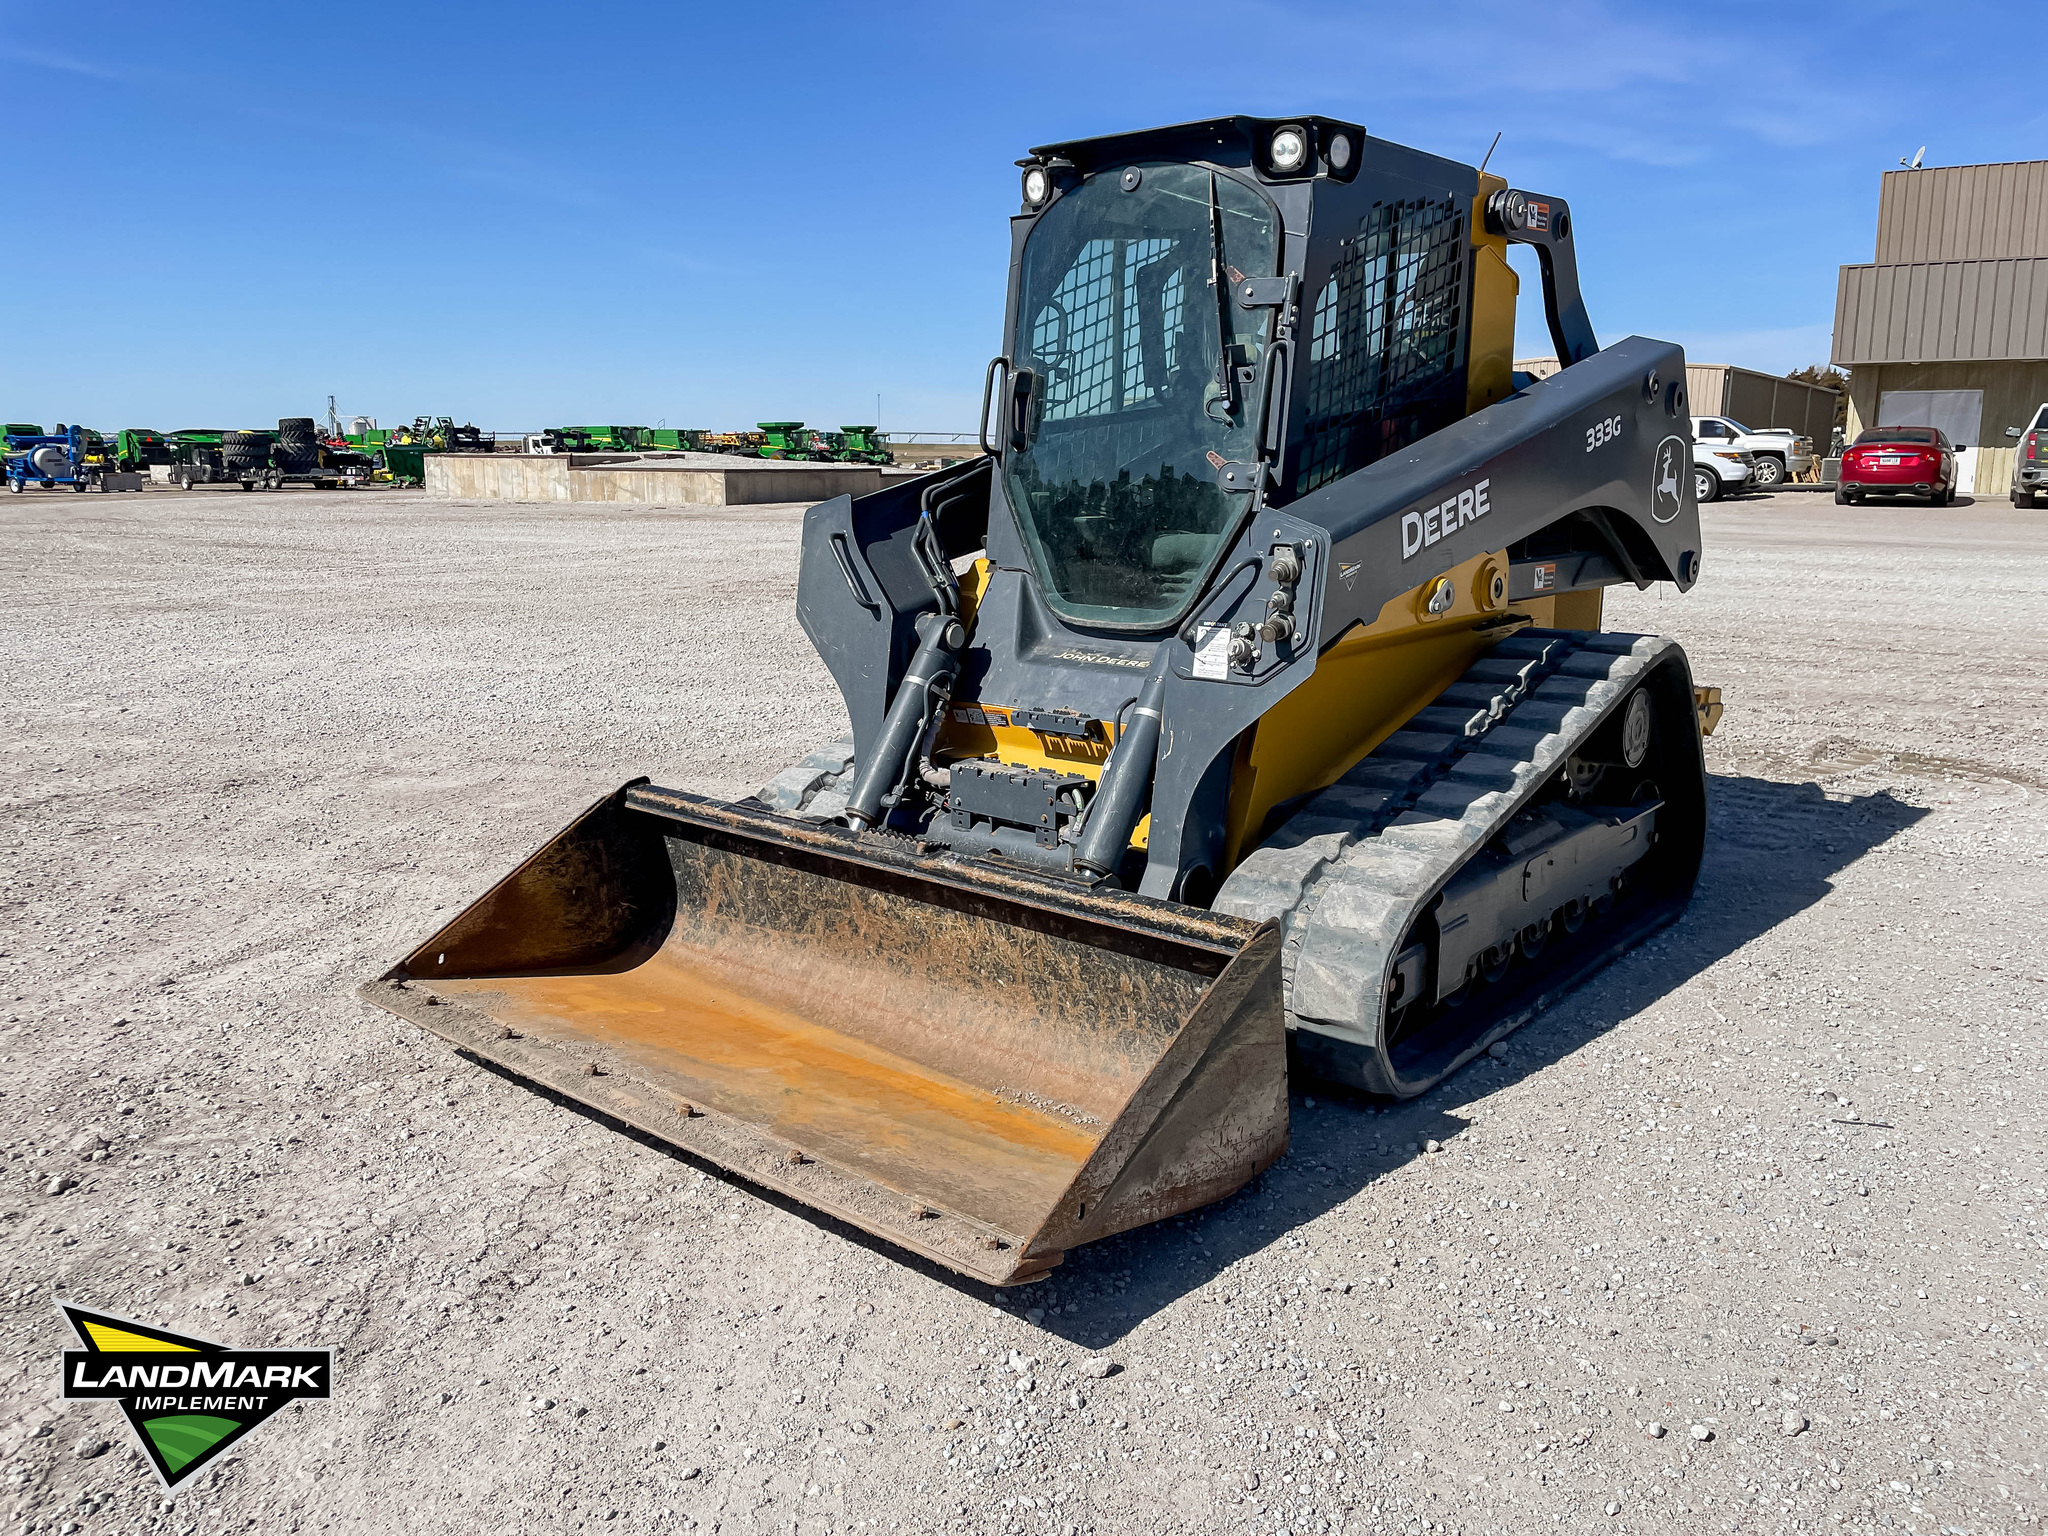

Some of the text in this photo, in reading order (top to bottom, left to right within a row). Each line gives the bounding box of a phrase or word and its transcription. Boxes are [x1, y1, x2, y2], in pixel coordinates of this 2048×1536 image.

[1586, 415, 1621, 452] 333G
[1401, 478, 1490, 560] DEERE
[1053, 652, 1151, 668] JOHN DEERE
